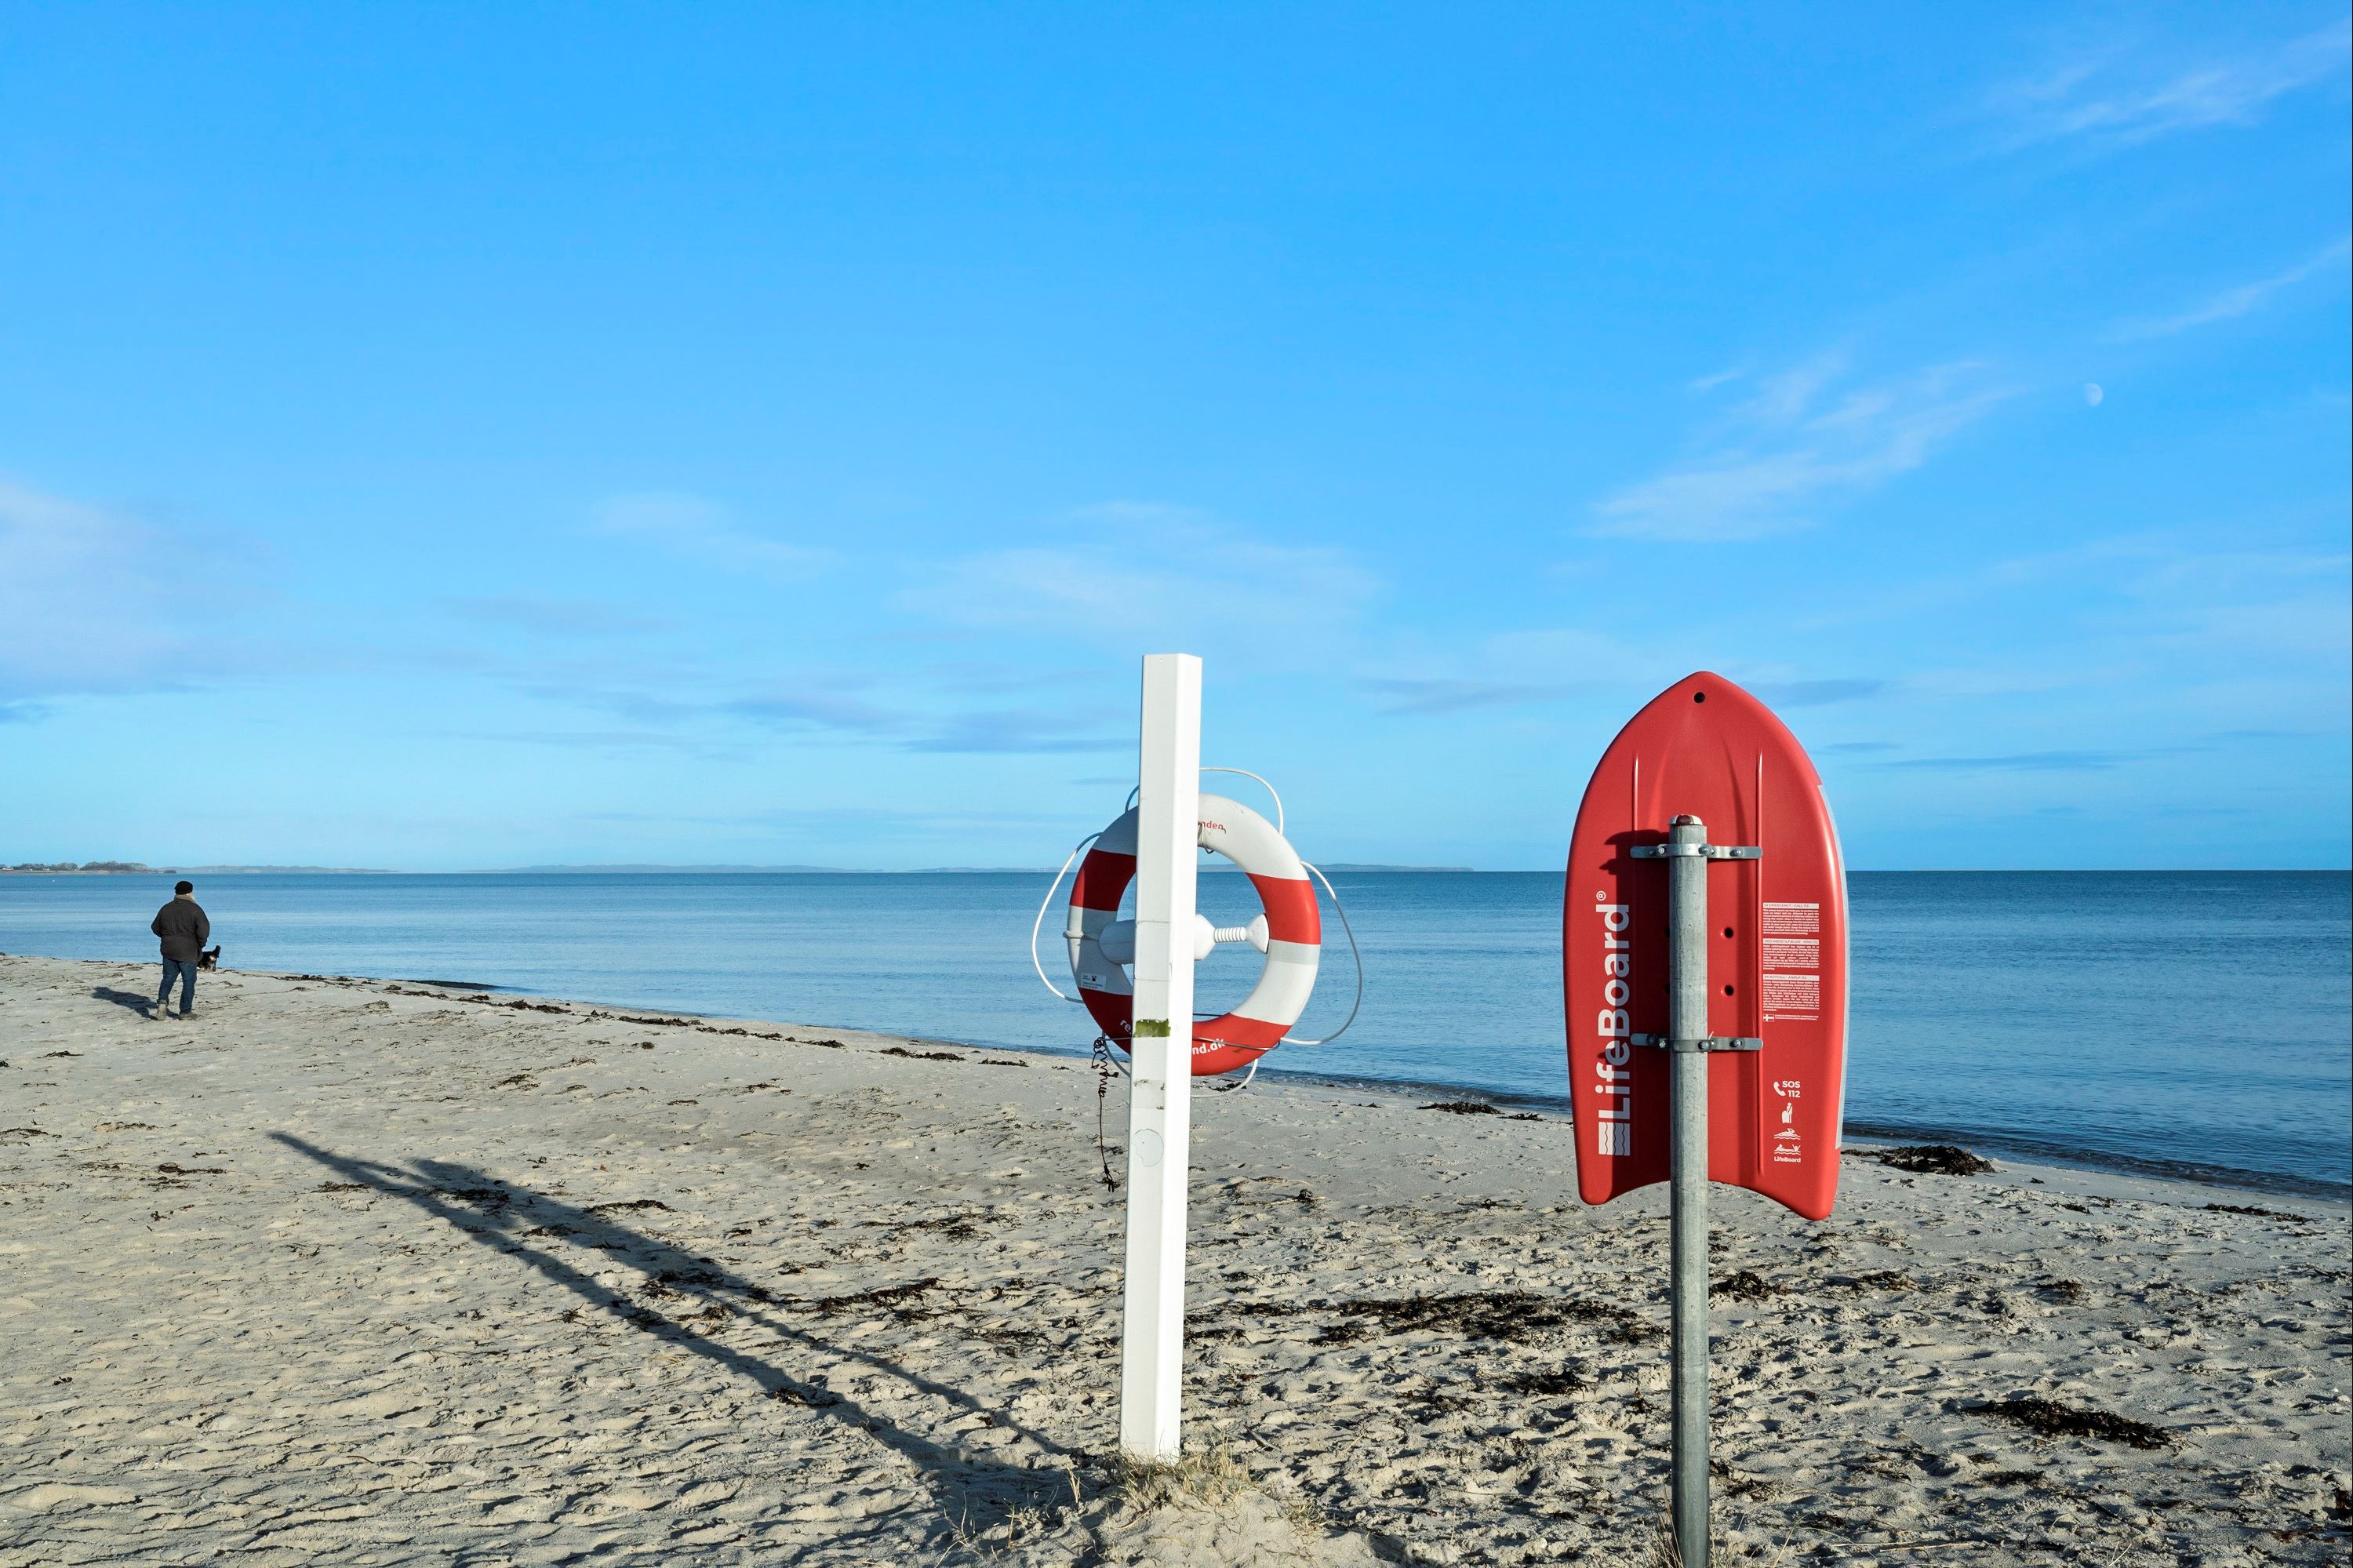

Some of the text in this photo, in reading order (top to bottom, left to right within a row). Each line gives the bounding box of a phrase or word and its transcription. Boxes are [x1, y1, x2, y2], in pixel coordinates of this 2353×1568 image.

[1191, 1038, 1225, 1055] nd.dk
[1781, 1080, 1801, 1089] SOS
[1787, 1090, 1801, 1098] 112
